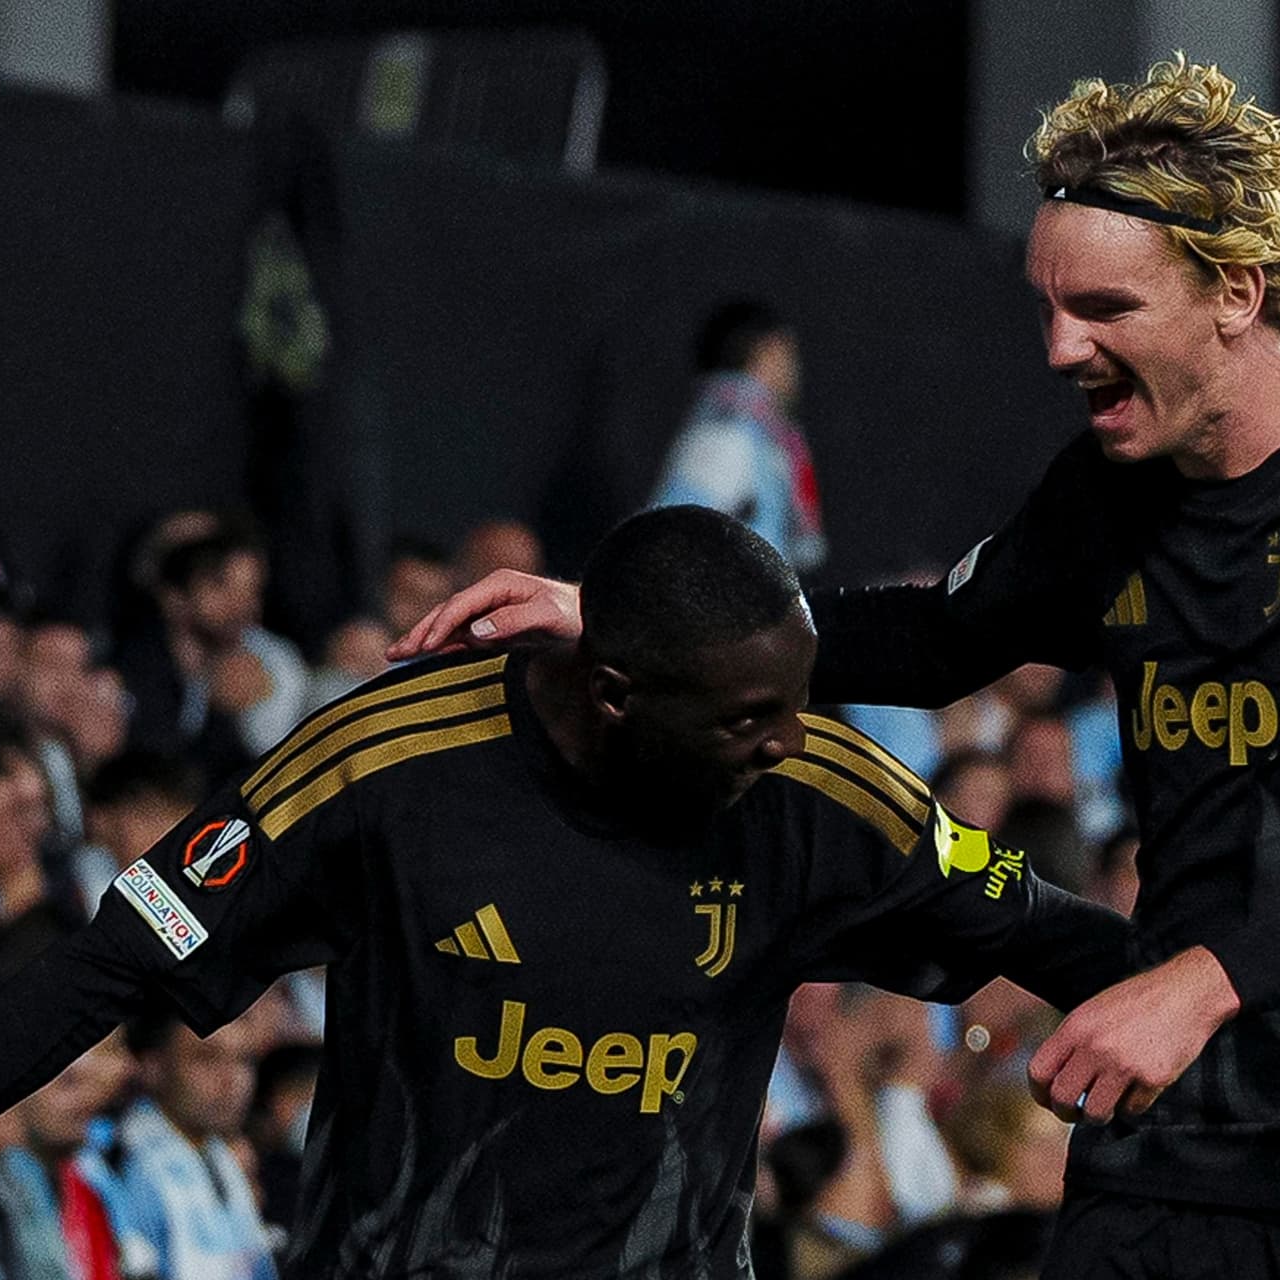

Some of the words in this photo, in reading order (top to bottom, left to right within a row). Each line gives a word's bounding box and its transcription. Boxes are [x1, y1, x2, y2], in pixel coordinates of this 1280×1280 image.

[1132, 661, 1279, 766] Jeep
[125, 867, 199, 950] FOUNDATION
[454, 1000, 698, 1113] Jeep
